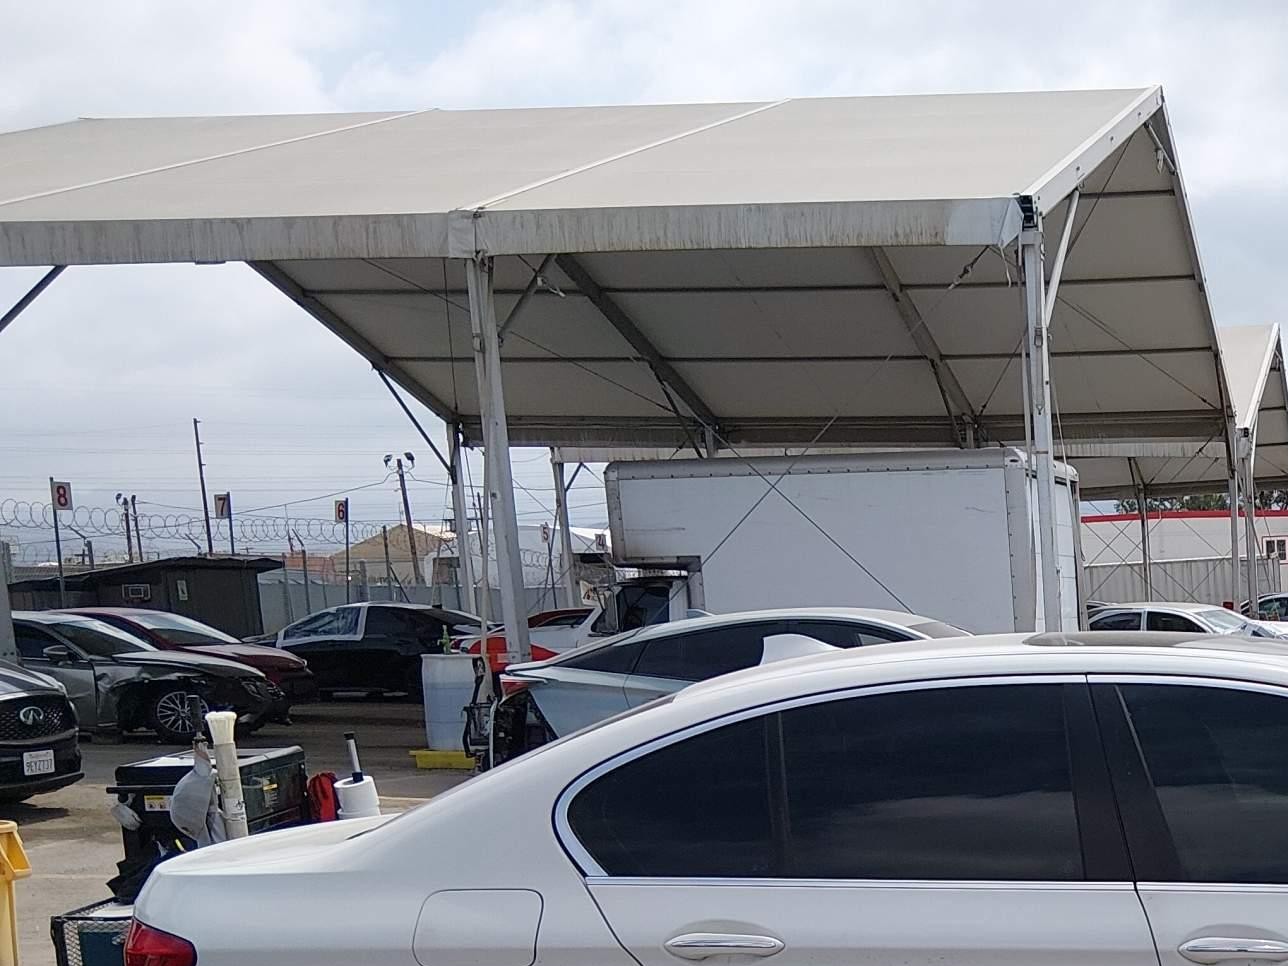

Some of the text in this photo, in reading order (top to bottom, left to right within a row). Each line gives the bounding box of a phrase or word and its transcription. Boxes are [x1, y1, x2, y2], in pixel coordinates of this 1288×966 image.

[55, 485, 68, 508] 8
[217, 497, 226, 517] 7
[337, 502, 345, 520] 6
[542, 526, 549, 541] 5
